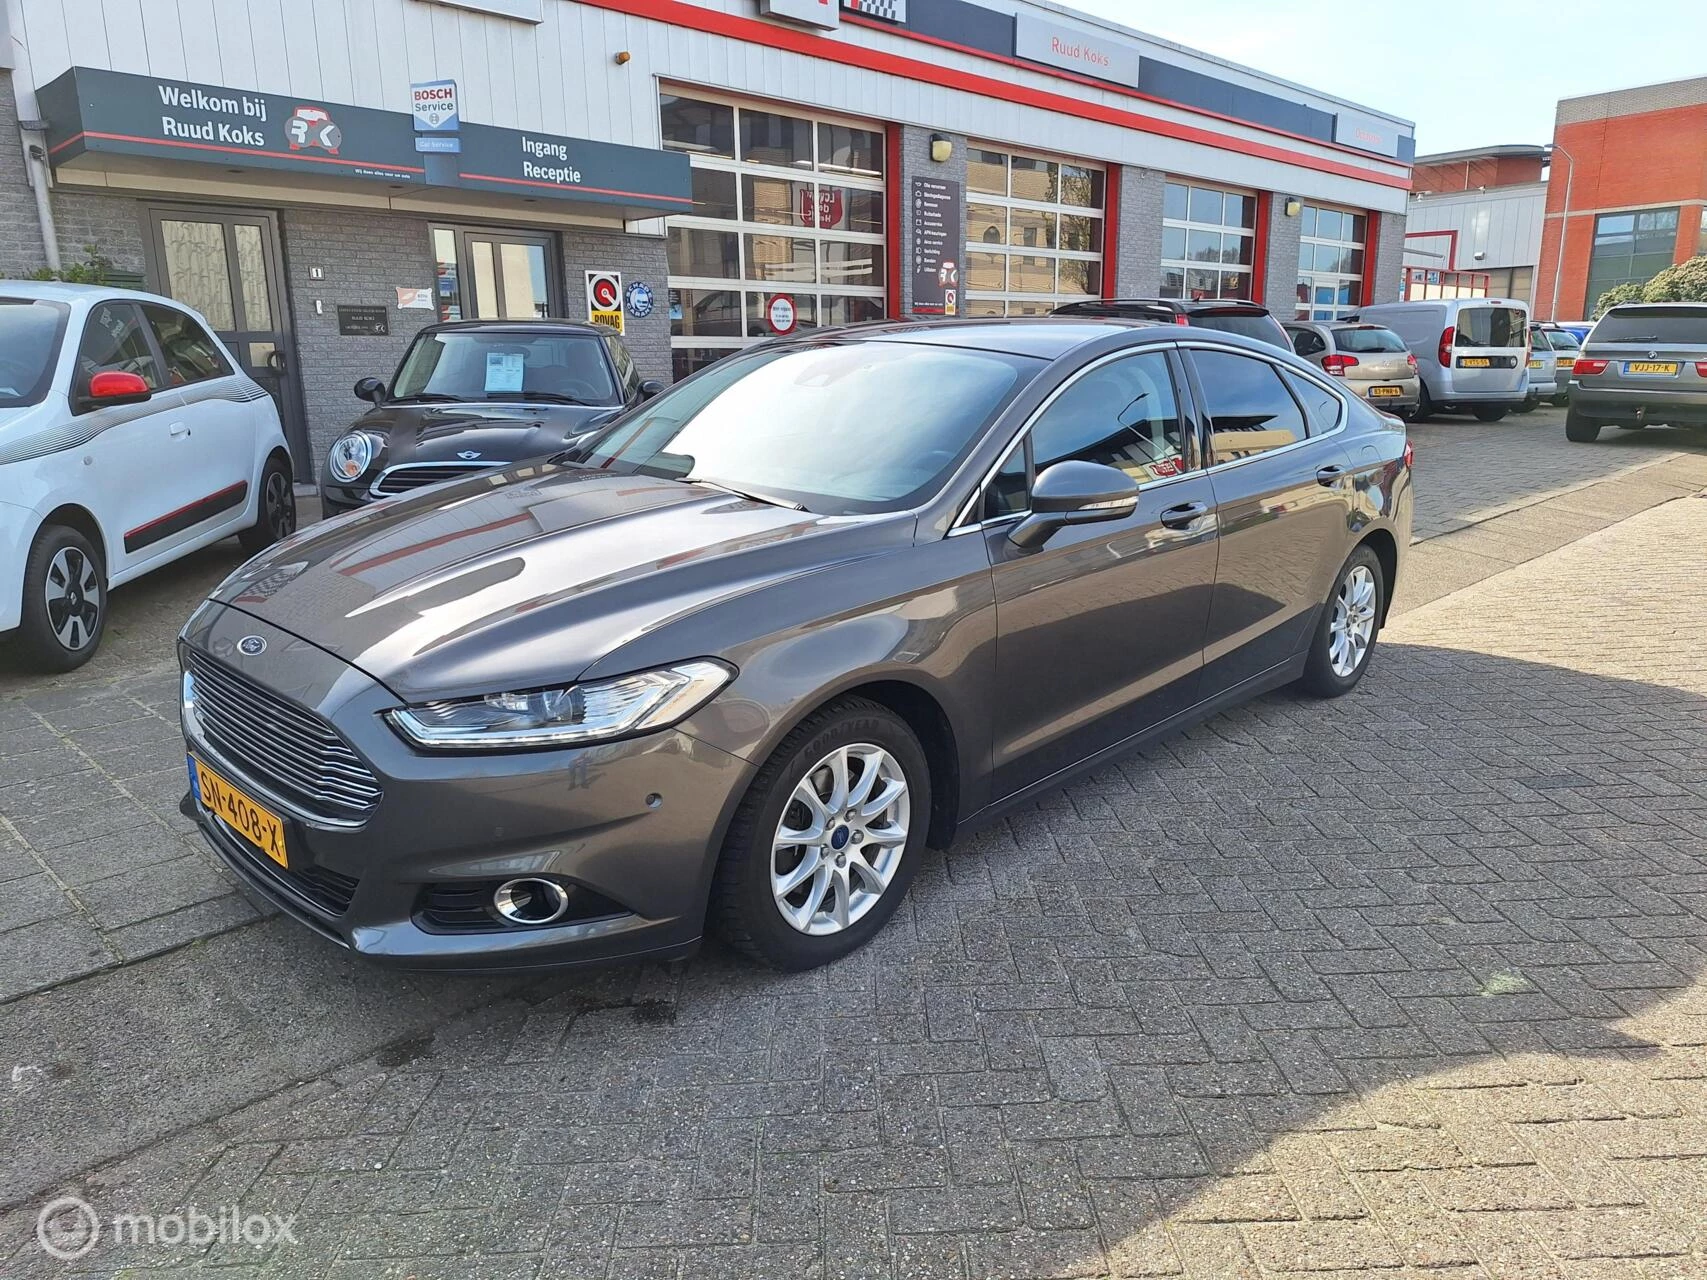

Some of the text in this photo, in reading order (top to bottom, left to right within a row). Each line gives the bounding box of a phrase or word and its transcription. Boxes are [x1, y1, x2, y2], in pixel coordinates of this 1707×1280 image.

[1052, 37, 1110, 66] Ruud Koks
[158, 85, 267, 122] Welkom bij
[414, 88, 453, 101] BOSCH
[415, 101, 454, 112] Service
[162, 117, 265, 146] Ruud Koks
[522, 136, 568, 161] Ingang
[523, 161, 581, 184] Receptie
[1634, 363, 1670, 373] VJJ-17-K
[200, 770, 281, 858] SN-408-X
